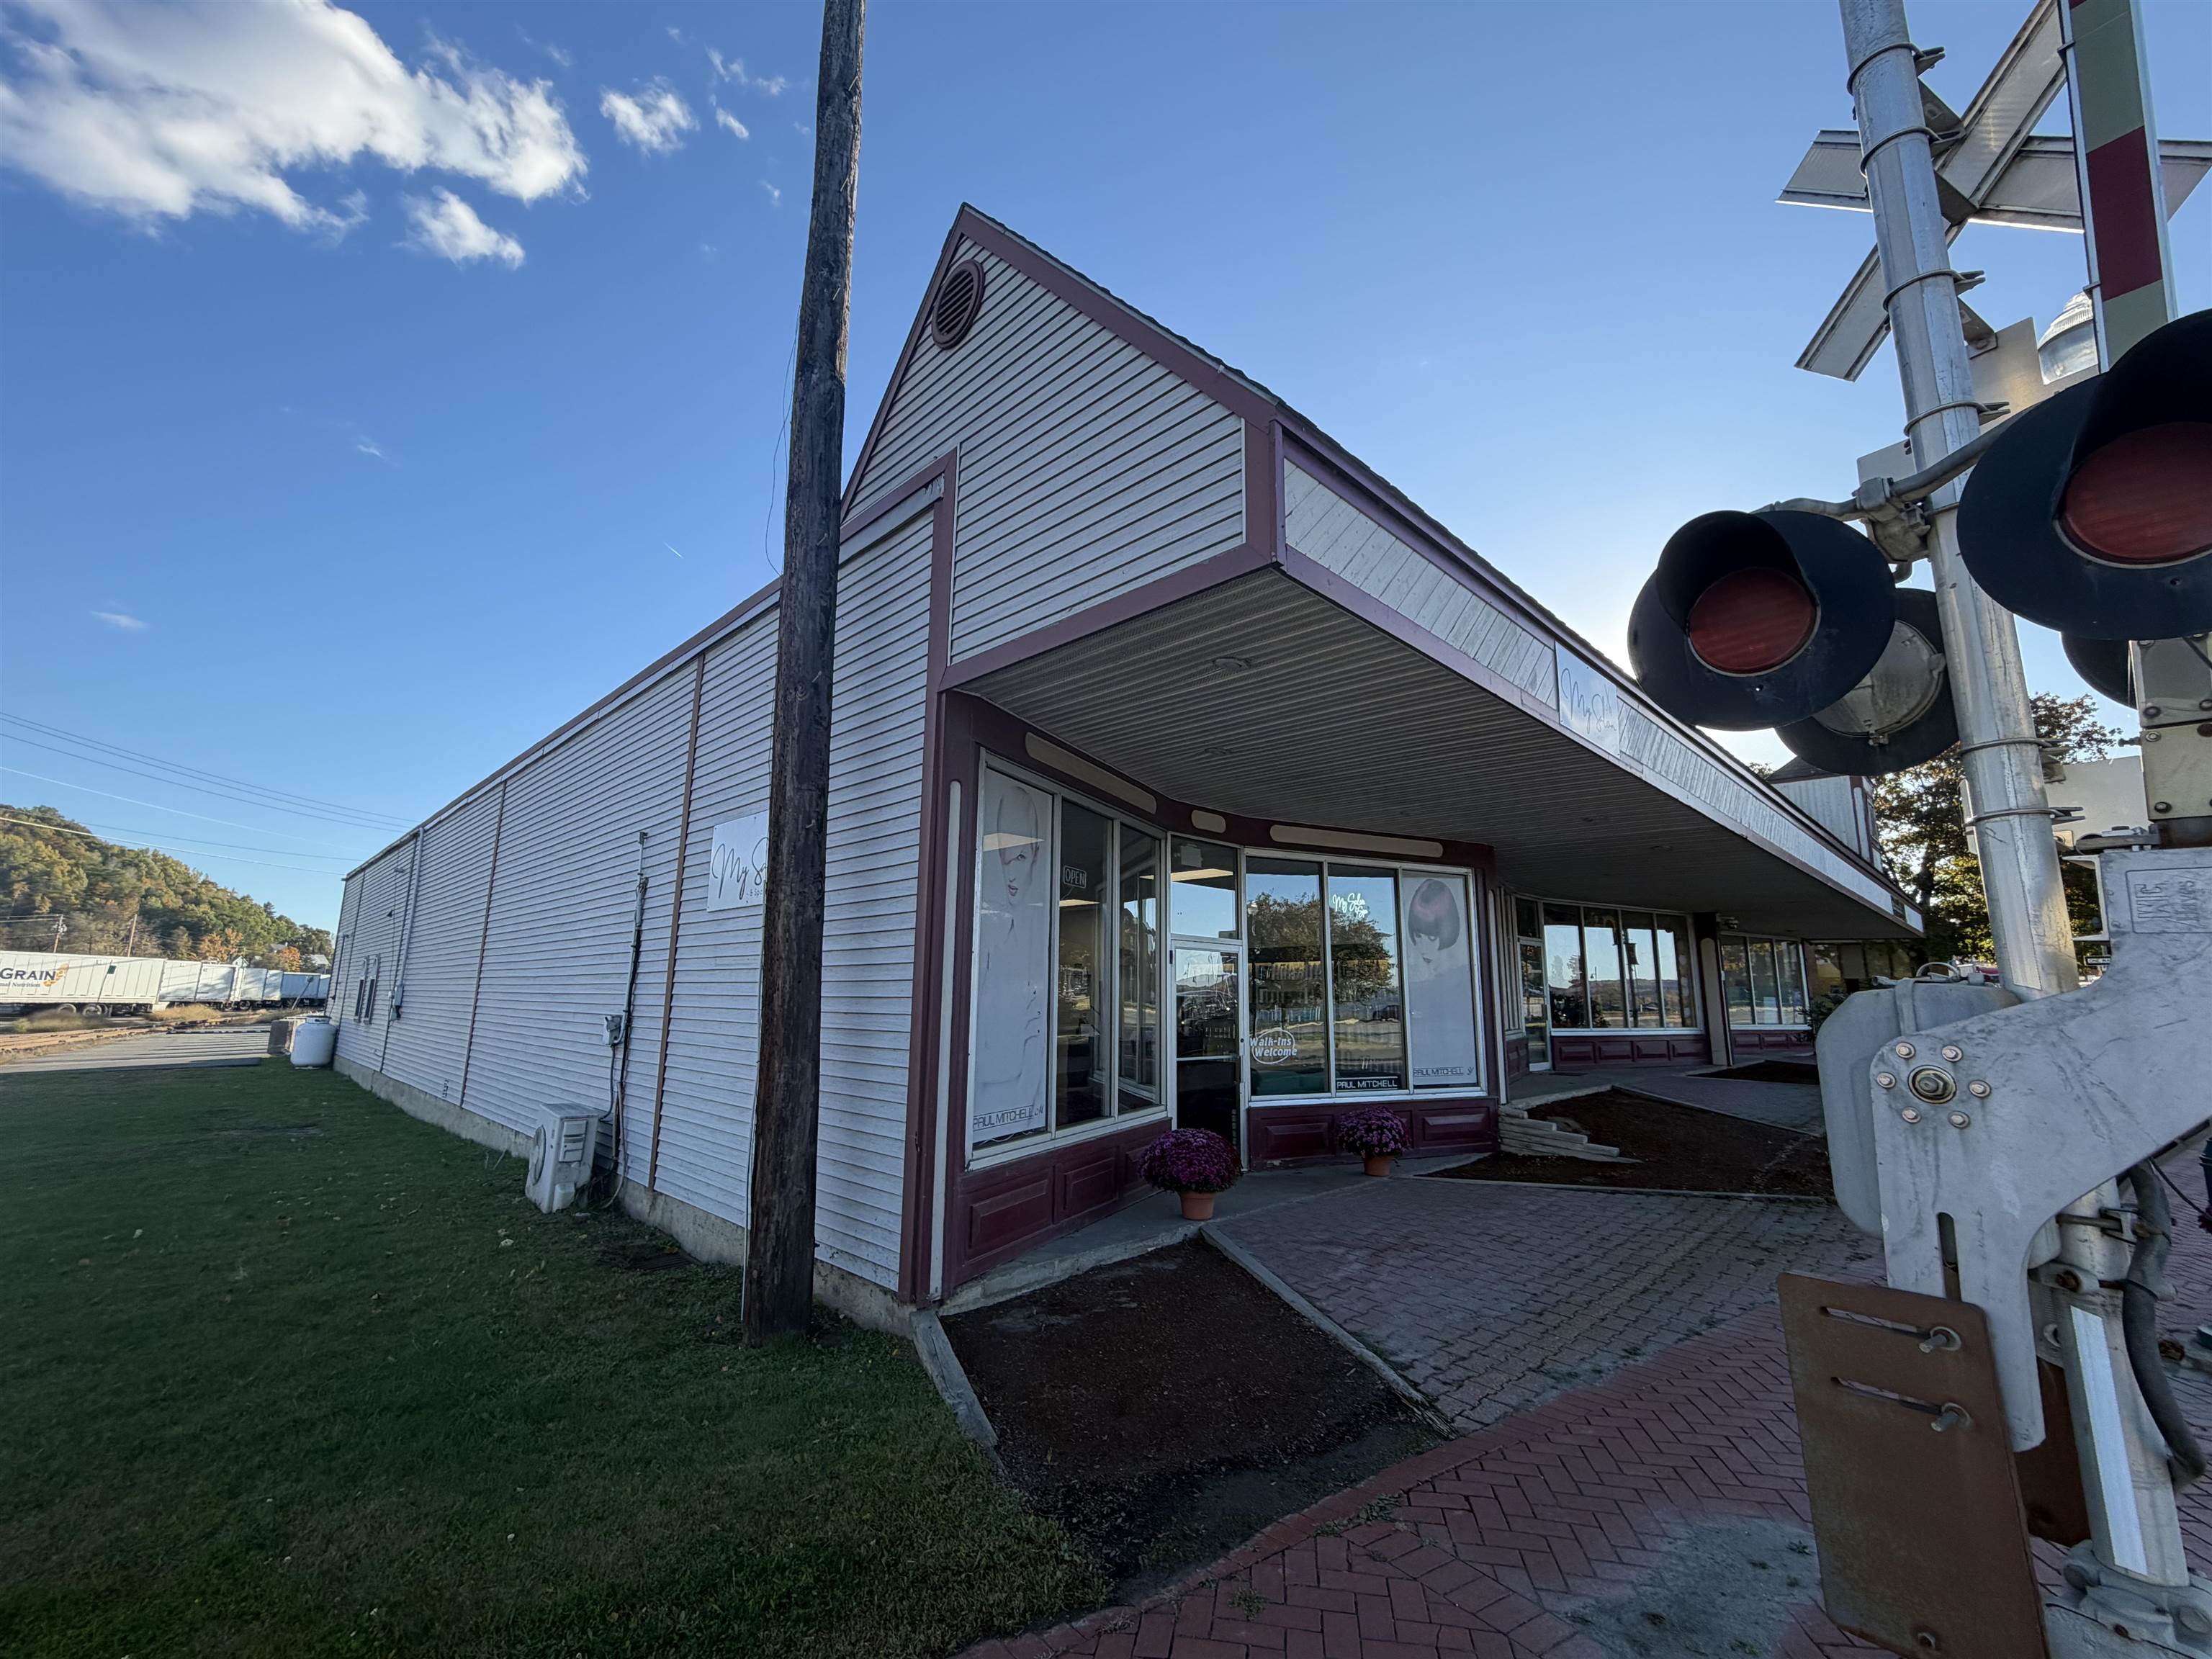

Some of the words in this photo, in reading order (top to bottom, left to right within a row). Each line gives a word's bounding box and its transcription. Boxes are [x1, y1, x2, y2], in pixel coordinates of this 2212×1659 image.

[1560, 667, 1592, 734] My
[711, 843, 749, 900] My
[1065, 868, 1085, 885] OPEN
[1332, 894, 1347, 913] My
[0, 967, 56, 981] GRAIN
[1249, 1037, 1292, 1047] Walk-Ins
[1254, 1047, 1298, 1057] Welcome
[1336, 1080, 1356, 1089] PAUL
[1357, 1079, 1398, 1088] MITCHELL
[973, 1116, 995, 1128] PAUL
[996, 1107, 1033, 1123] MITCHELL
